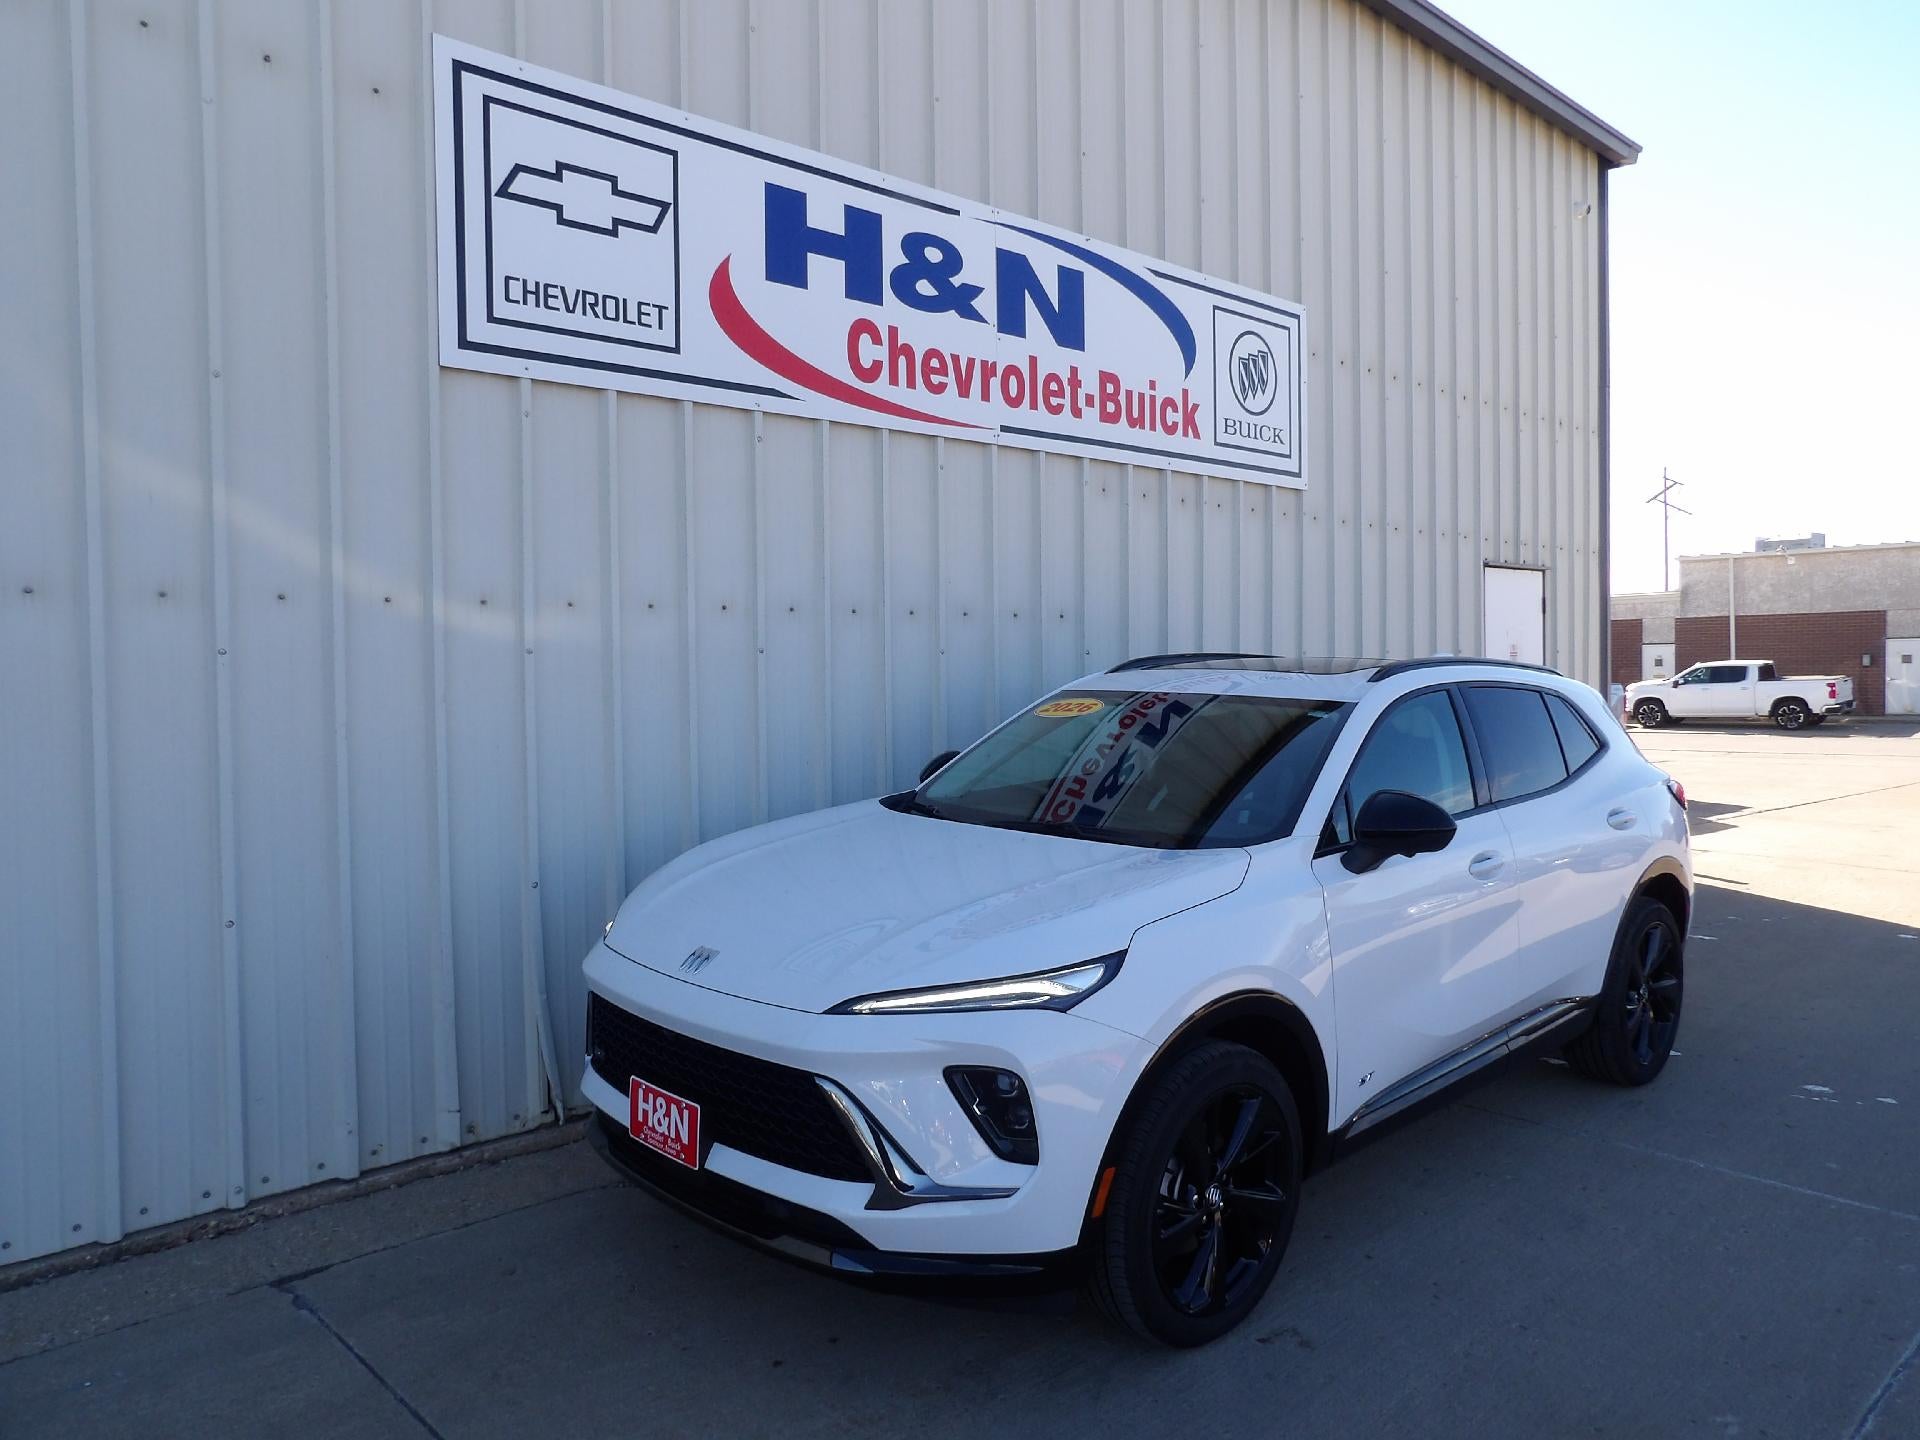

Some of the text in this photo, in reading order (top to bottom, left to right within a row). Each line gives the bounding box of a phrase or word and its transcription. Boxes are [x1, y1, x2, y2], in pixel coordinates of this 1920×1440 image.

[765, 181, 1087, 352] H&N
[504, 275, 669, 331] CHEVROLET
[847, 317, 1201, 440] Chevrolet-Buick
[1222, 417, 1286, 446] BUICK
[1039, 702, 1098, 713] 2026
[638, 1087, 689, 1146] H&N
